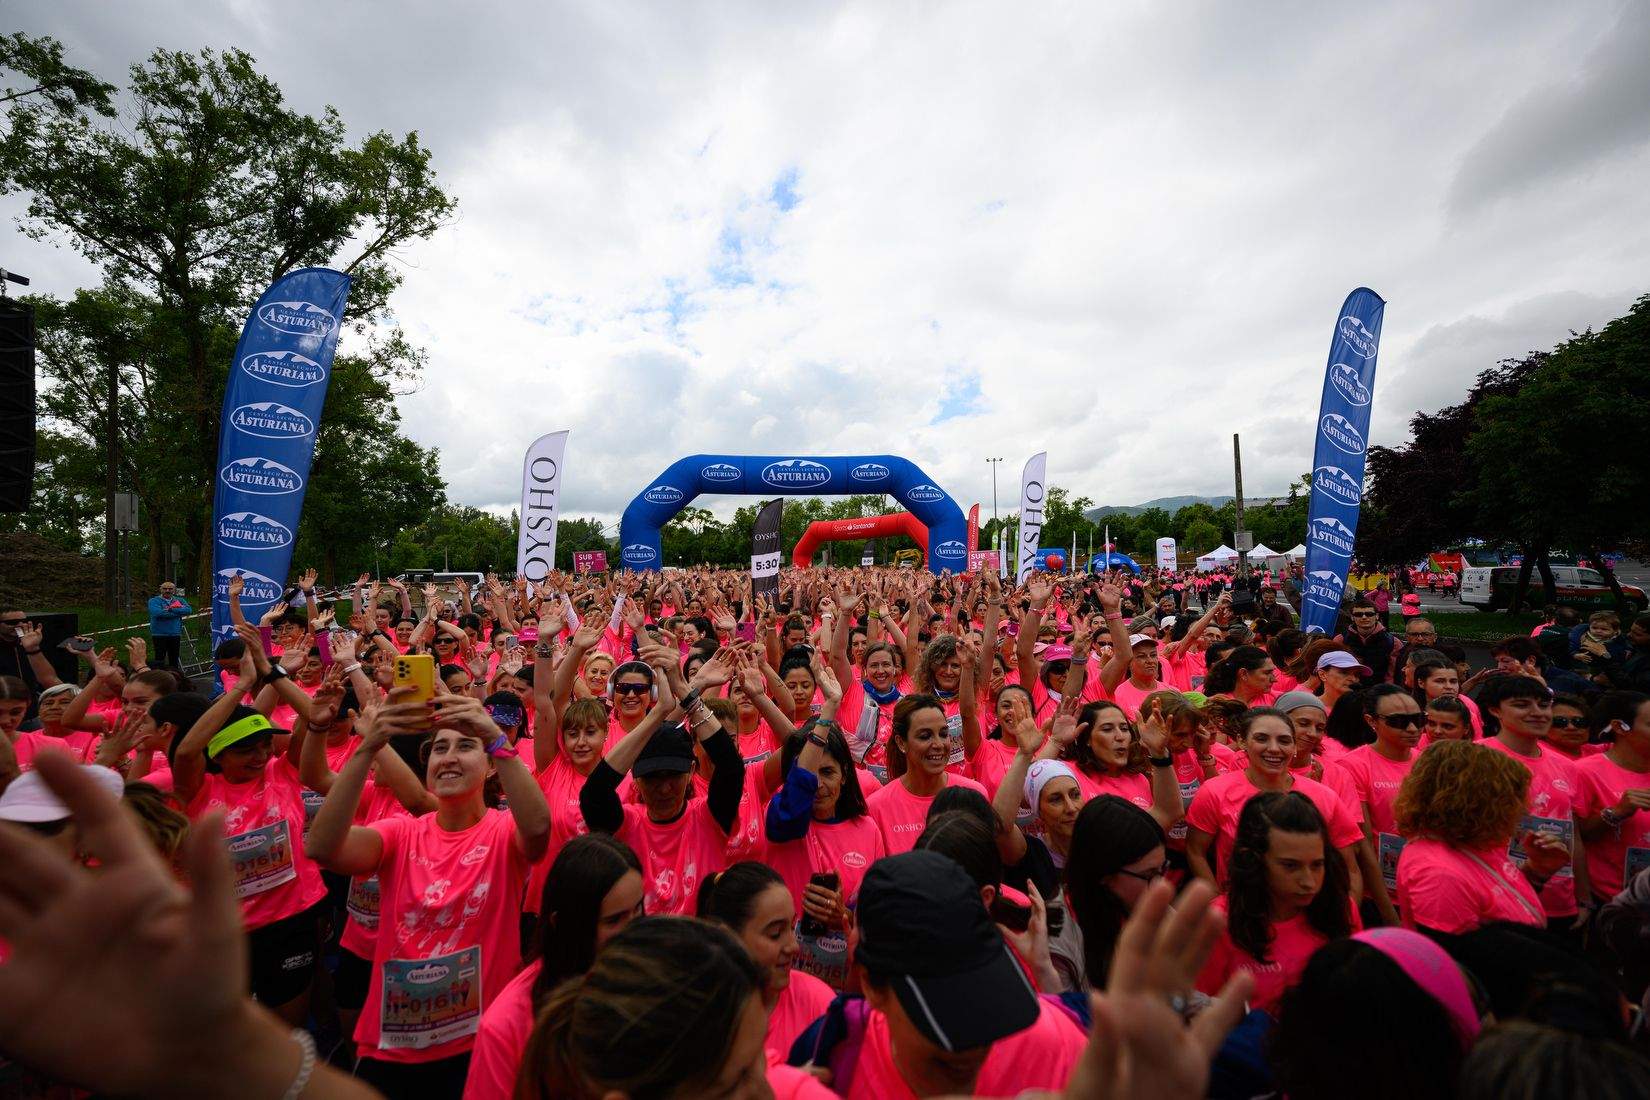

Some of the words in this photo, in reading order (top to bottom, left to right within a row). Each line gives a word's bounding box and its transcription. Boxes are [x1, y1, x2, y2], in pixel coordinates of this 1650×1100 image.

[247, 358, 318, 380] ASTURIANA
[235, 411, 305, 434] ASTURIANA
[1323, 418, 1361, 452] ASTURIANA
[227, 467, 294, 490] ASTURIANA
[705, 468, 738, 478] ASTURIANA
[767, 468, 826, 481] ASTURIANA
[853, 469, 887, 478] ASTURIANA
[1315, 472, 1359, 502] ASTURIANA
[647, 492, 680, 500] ASTURIANA
[523, 456, 557, 582] OYSHO
[578, 553, 593, 561] SUB
[893, 823, 924, 832] OYSHO
